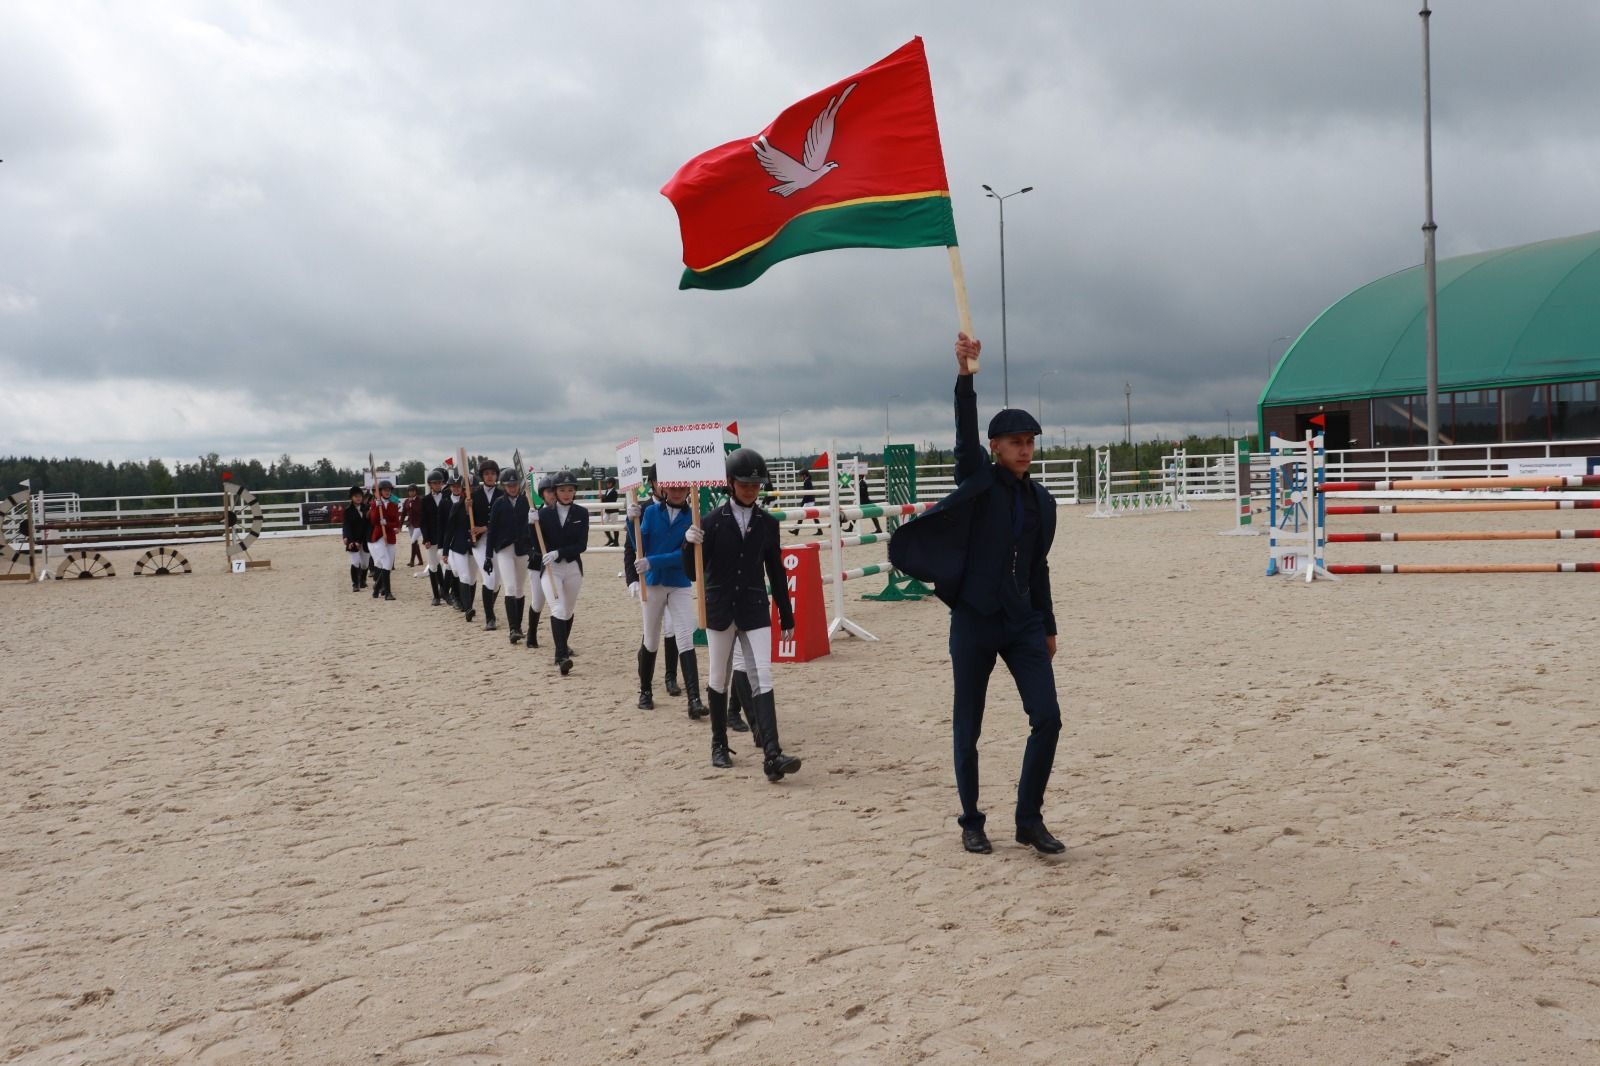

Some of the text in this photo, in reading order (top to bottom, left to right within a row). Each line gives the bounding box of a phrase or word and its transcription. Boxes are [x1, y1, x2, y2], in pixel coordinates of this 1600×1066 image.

[663, 441, 715, 456] АЗНАКАЕВСКИЙ
[678, 457, 701, 468] РАЙОН
[235, 562, 242, 570] 7
[1283, 555, 1295, 569] 11
